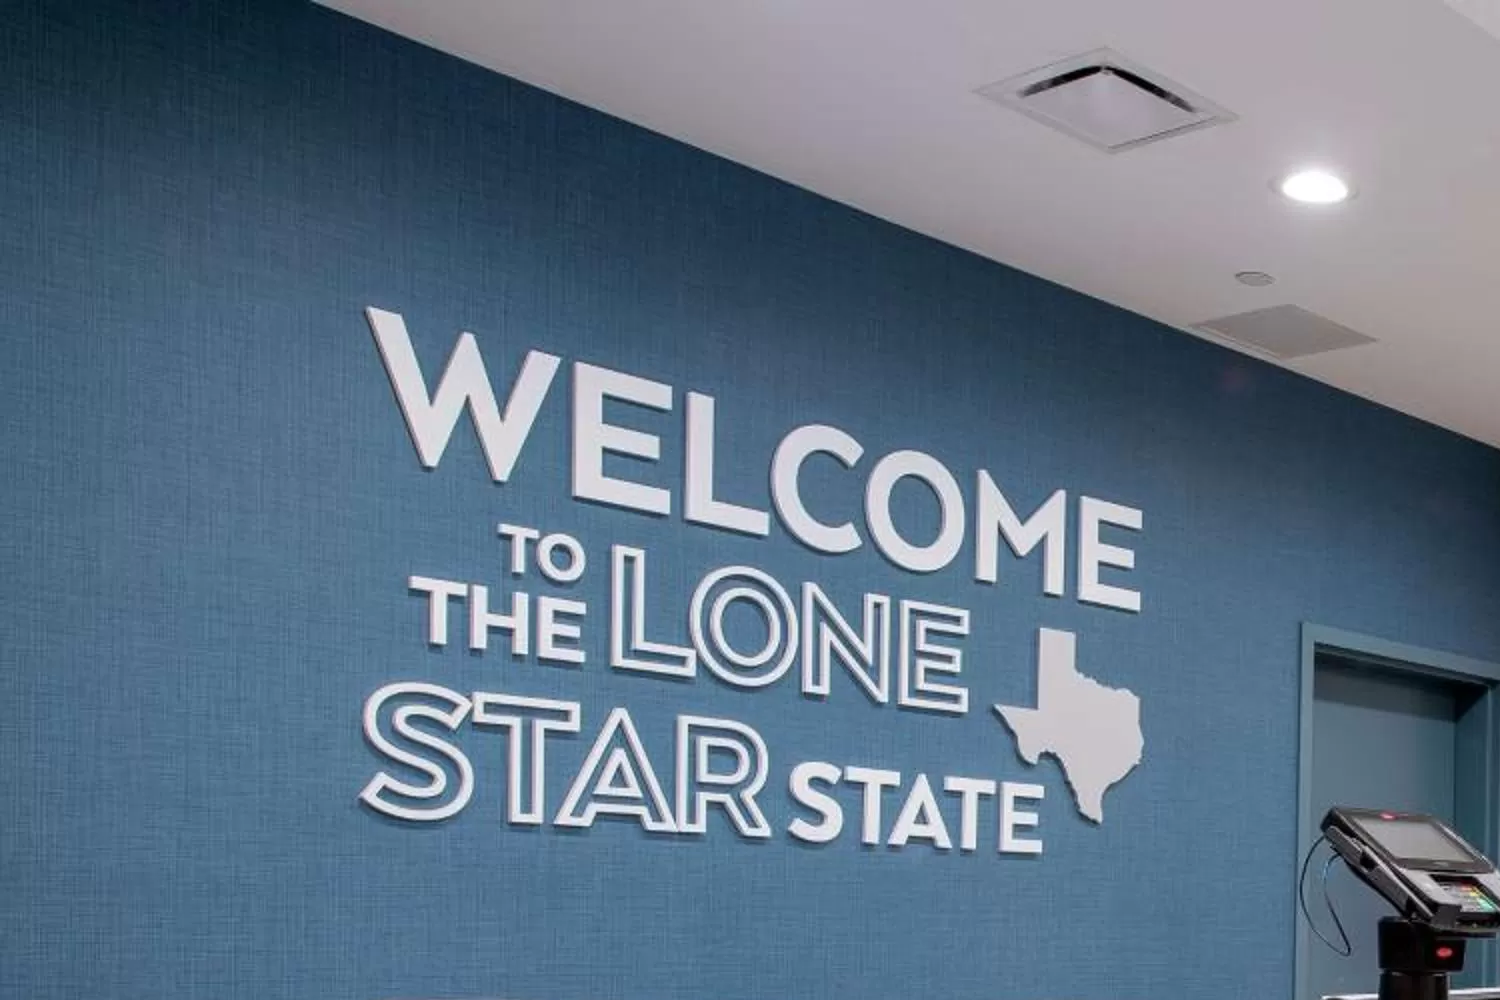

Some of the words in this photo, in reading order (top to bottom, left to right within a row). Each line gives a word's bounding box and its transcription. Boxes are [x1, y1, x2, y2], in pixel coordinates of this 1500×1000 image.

[365, 304, 1144, 612] WELCOME
[408, 575, 588, 664] THE
[611, 543, 971, 714] LONE
[497, 522, 587, 583] TO
[359, 680, 771, 837] STAR
[788, 761, 1046, 853] STATE
